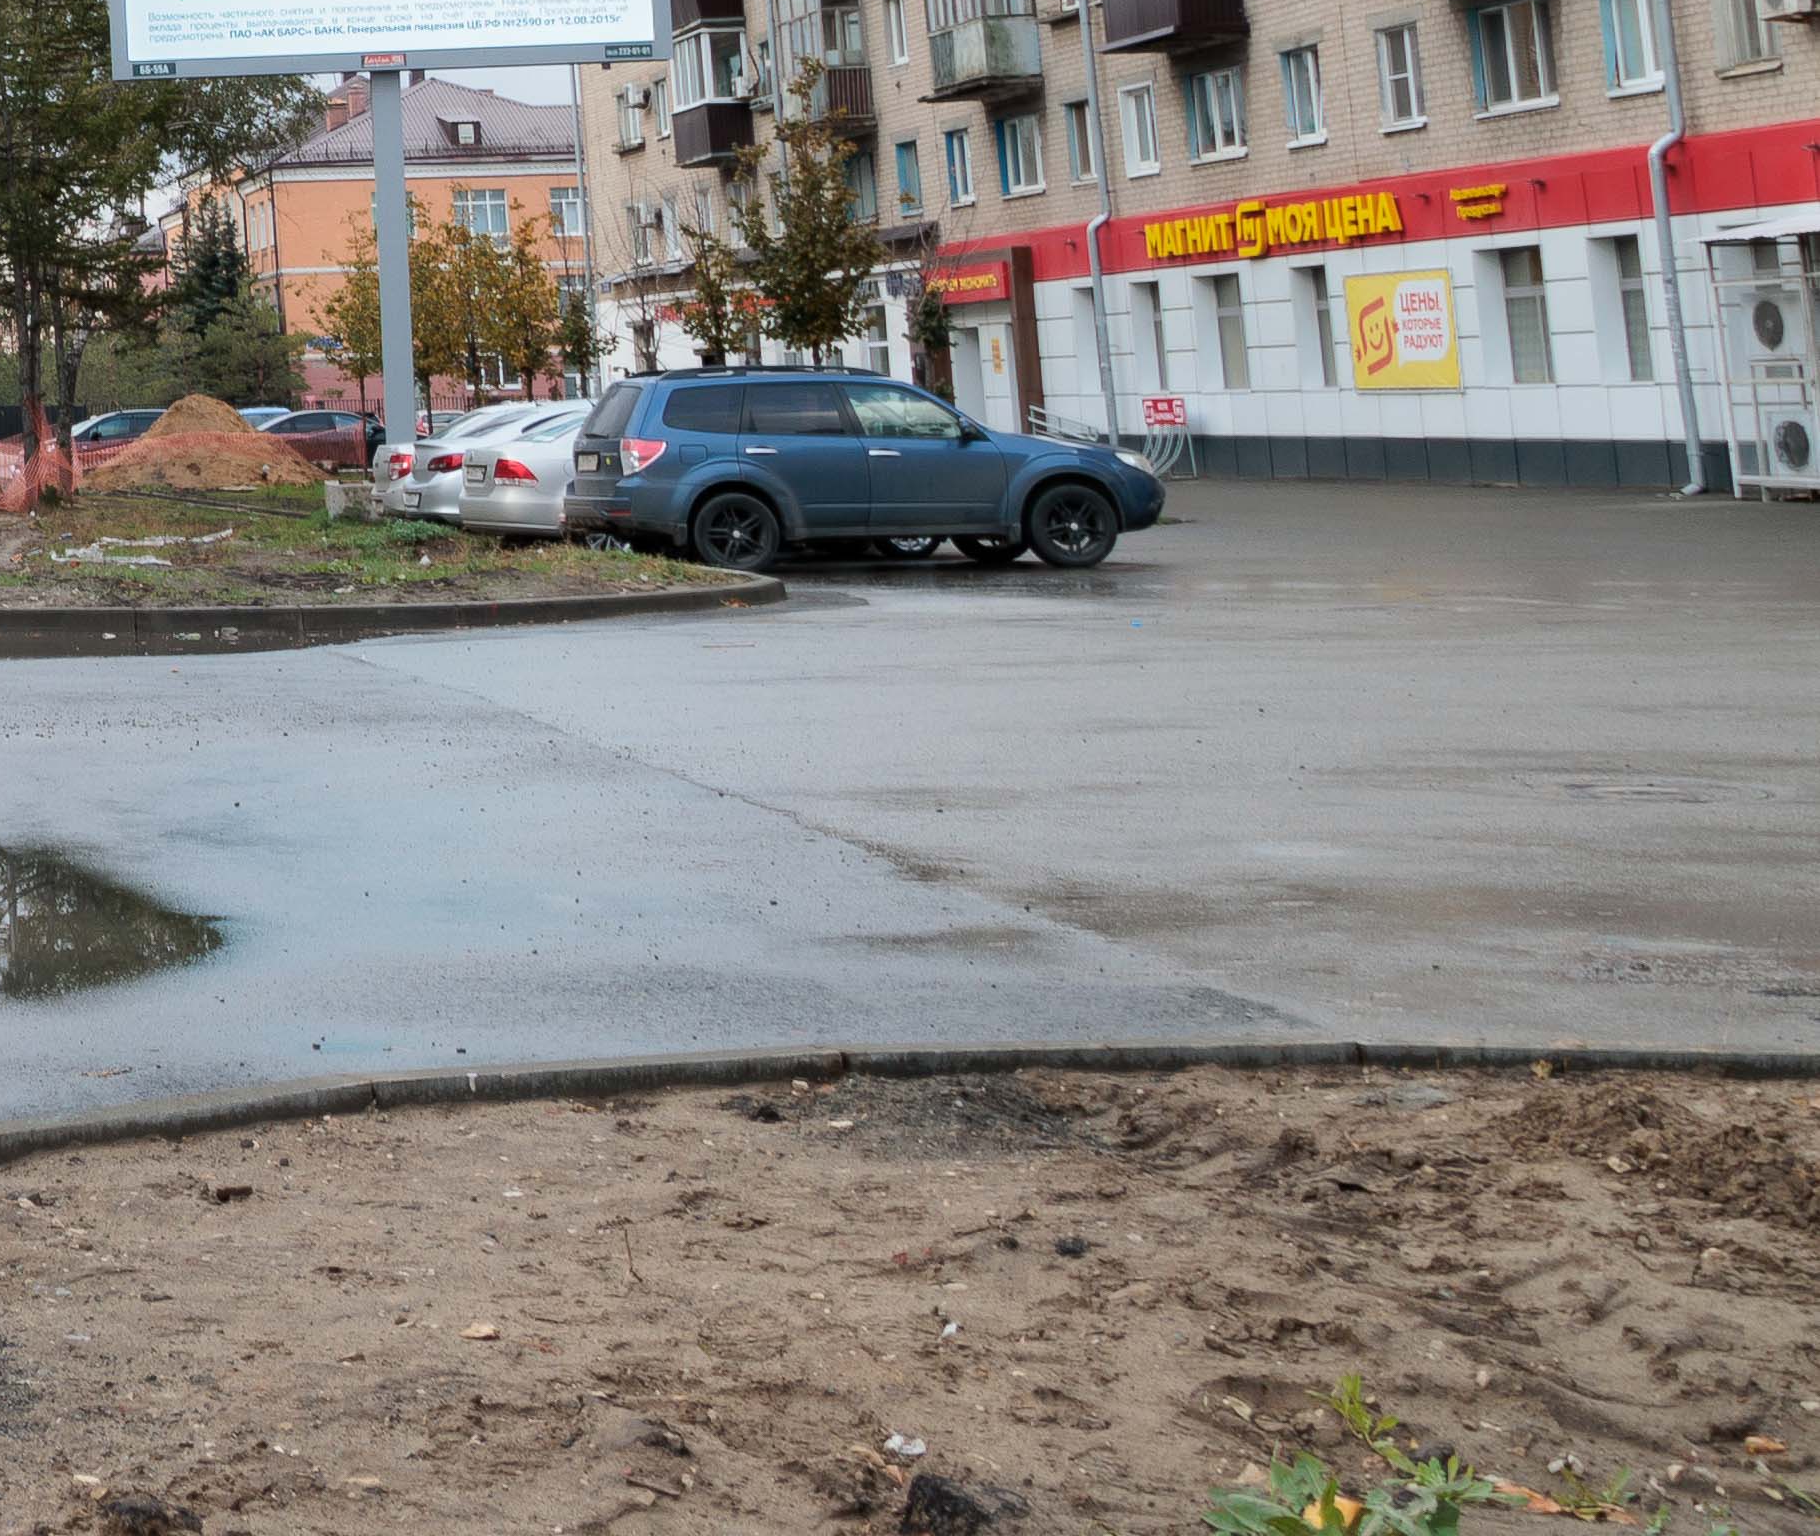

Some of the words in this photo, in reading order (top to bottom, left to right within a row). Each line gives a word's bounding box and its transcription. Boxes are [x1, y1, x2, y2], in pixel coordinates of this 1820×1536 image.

[230, 30, 252, 39] ПАО
[1144, 215, 1235, 259] МАГНИТ
[1265, 201, 1319, 247] МОЯ
[1323, 191, 1404, 245] ЦЕНА
[1400, 291, 1443, 315] ЦЕНЫ,
[1402, 317, 1443, 331] КОТОРЫЕ
[1403, 334, 1444, 350] РАДУЮТ
